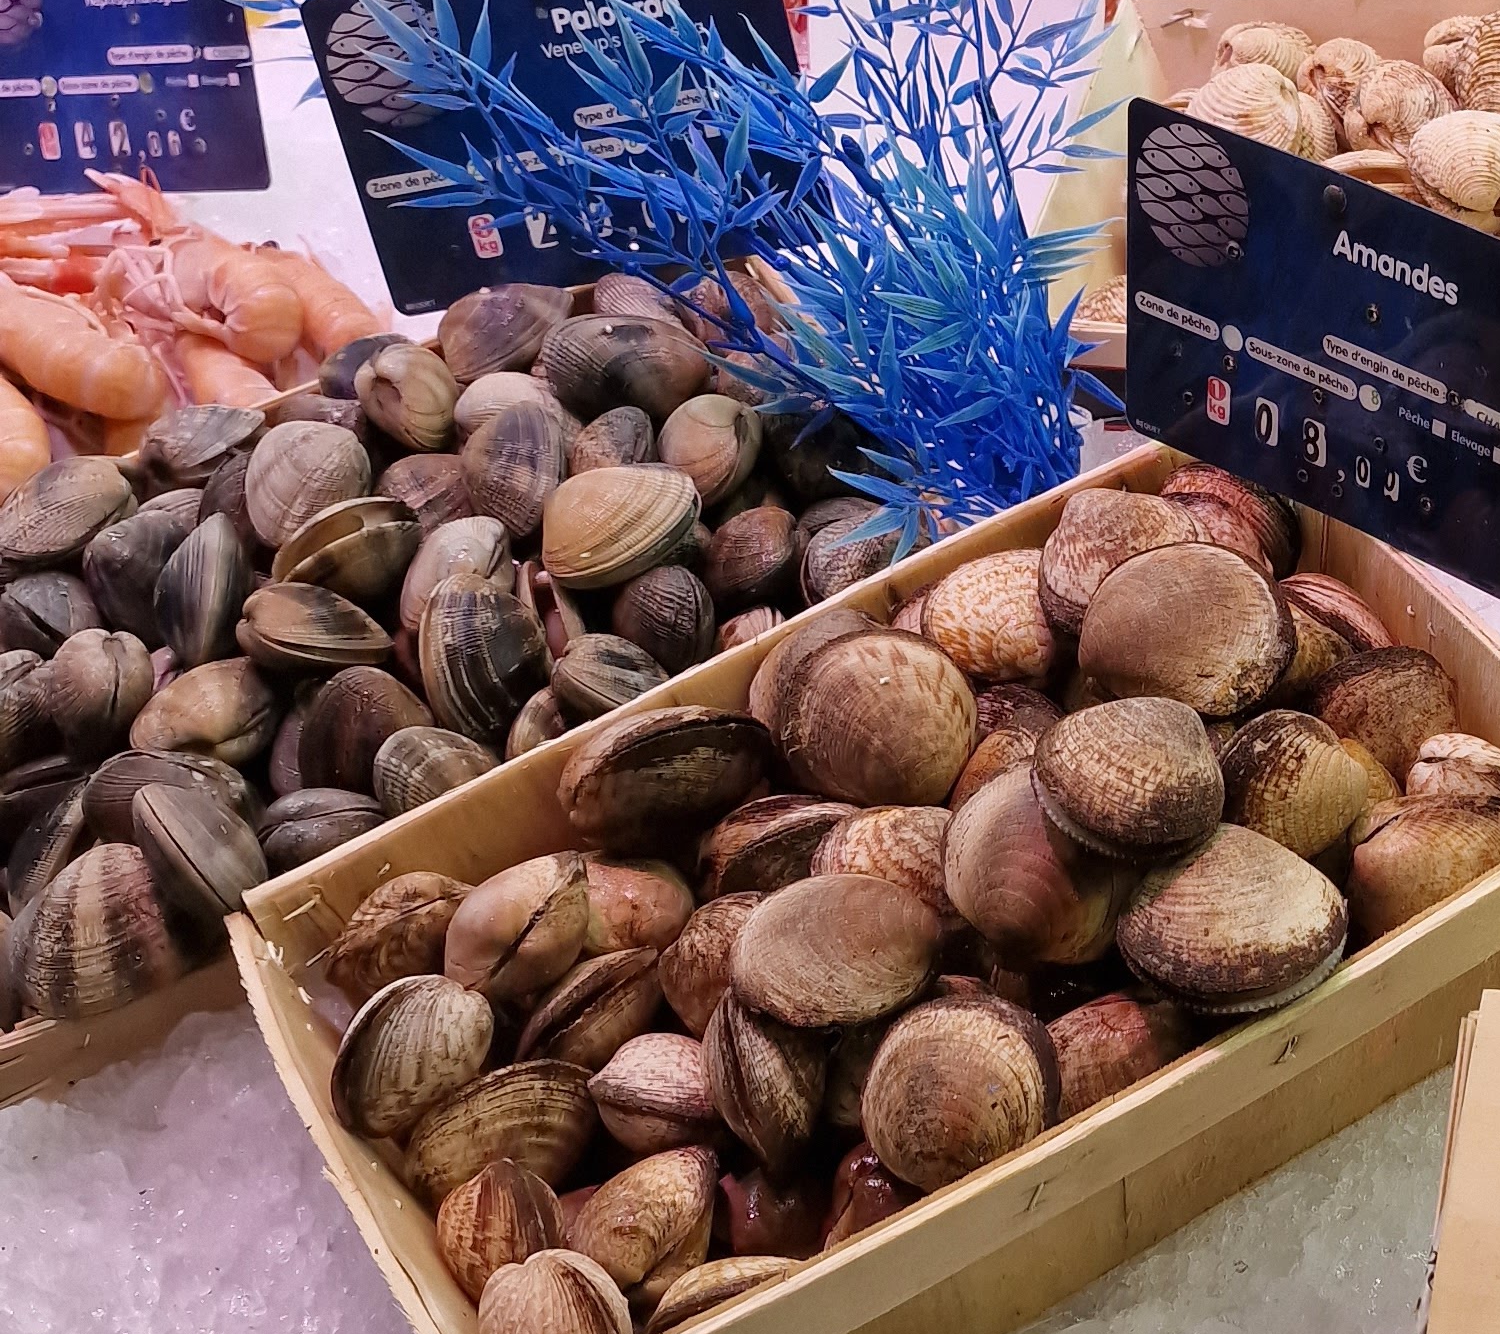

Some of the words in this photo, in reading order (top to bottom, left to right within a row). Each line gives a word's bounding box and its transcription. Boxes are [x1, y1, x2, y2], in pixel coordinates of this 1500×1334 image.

[372, 180, 402, 193] Zone
[405, 176, 419, 187] de
[1332, 229, 1459, 305] Amandes
[1139, 294, 1164, 314] Zone
[1166, 305, 1179, 320] de
[1248, 340, 1301, 372] Sous-zone
[1302, 363, 1316, 379] de
[1325, 338, 1348, 358] Type
[1351, 351, 1389, 376] d'engin
[1391, 368, 1405, 383] de
[1208, 397, 1227, 420] kg
[1398, 405, 1431, 430] Pêche
[1451, 429, 1492, 458] Elevage
[1406, 454, 1429, 484] €
